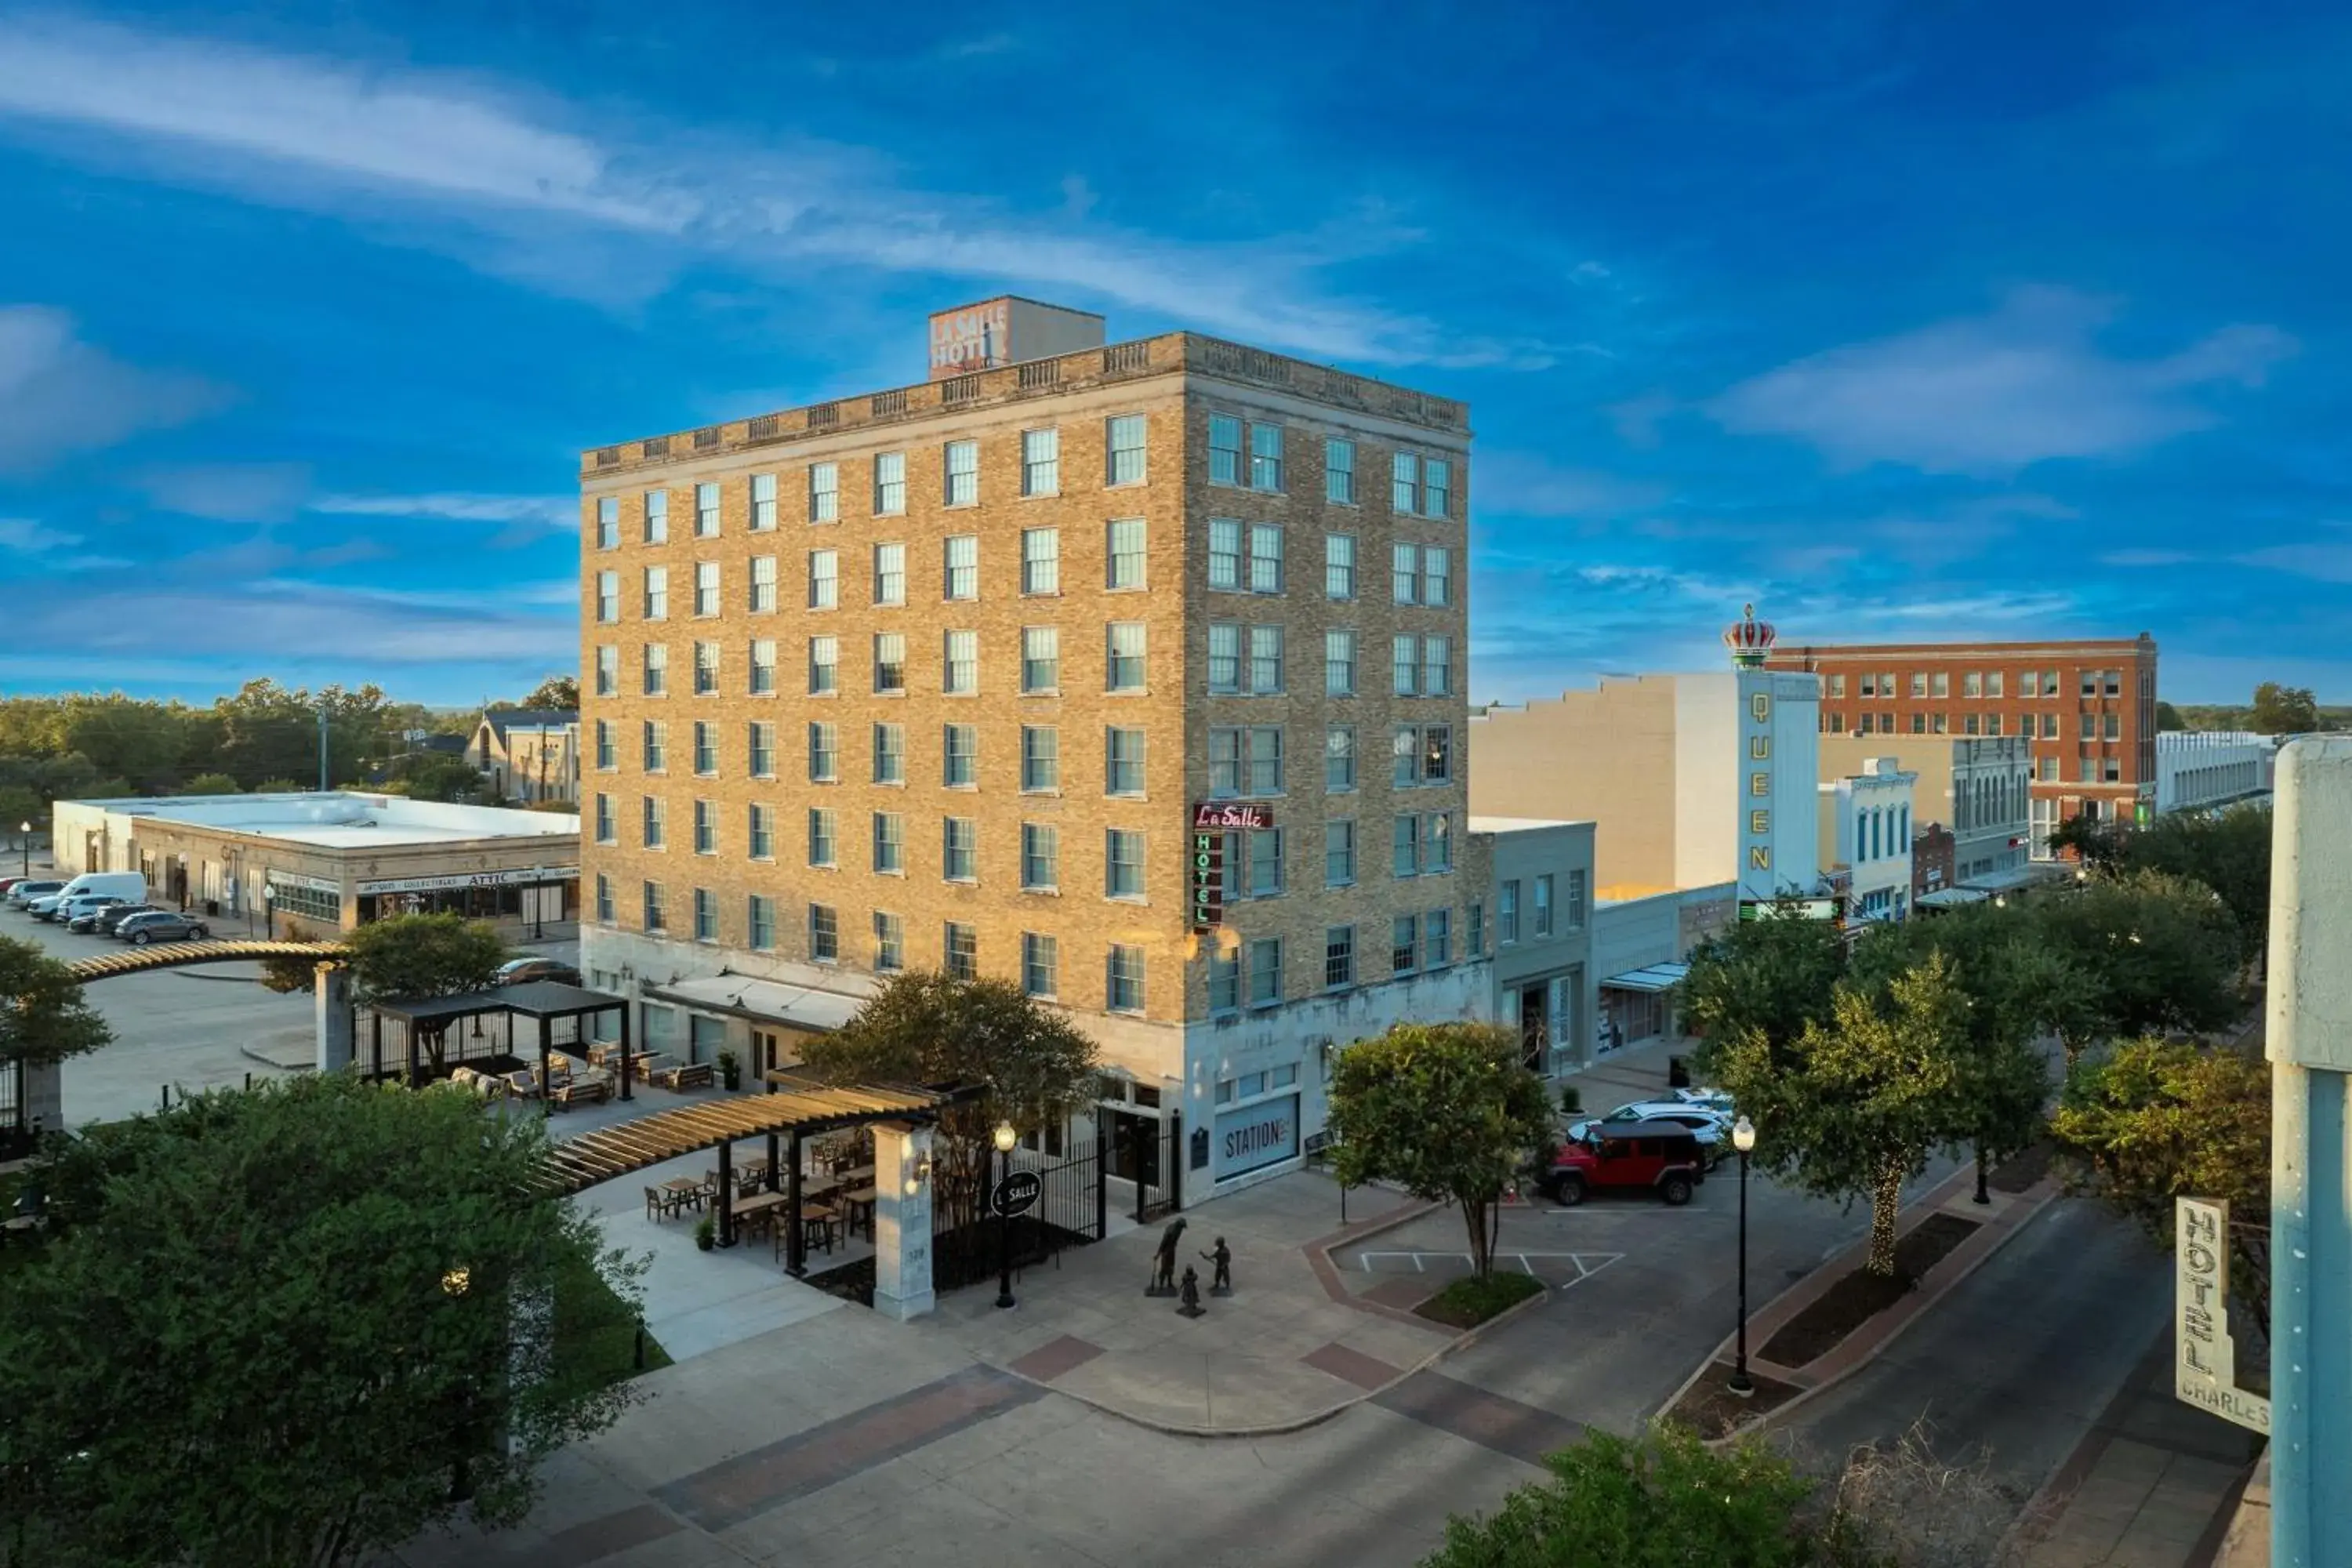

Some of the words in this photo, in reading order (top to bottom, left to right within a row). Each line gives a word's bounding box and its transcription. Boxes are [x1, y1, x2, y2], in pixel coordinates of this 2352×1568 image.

[1751, 693, 1769, 870] QUEEN
[469, 873, 509, 885] ATTIC
[1197, 834, 1210, 923] HOTEL
[1225, 1119, 1279, 1158] STATION
[2183, 1207, 2217, 1376] HOTEL
[2182, 1379, 2270, 1428] CHARLES
